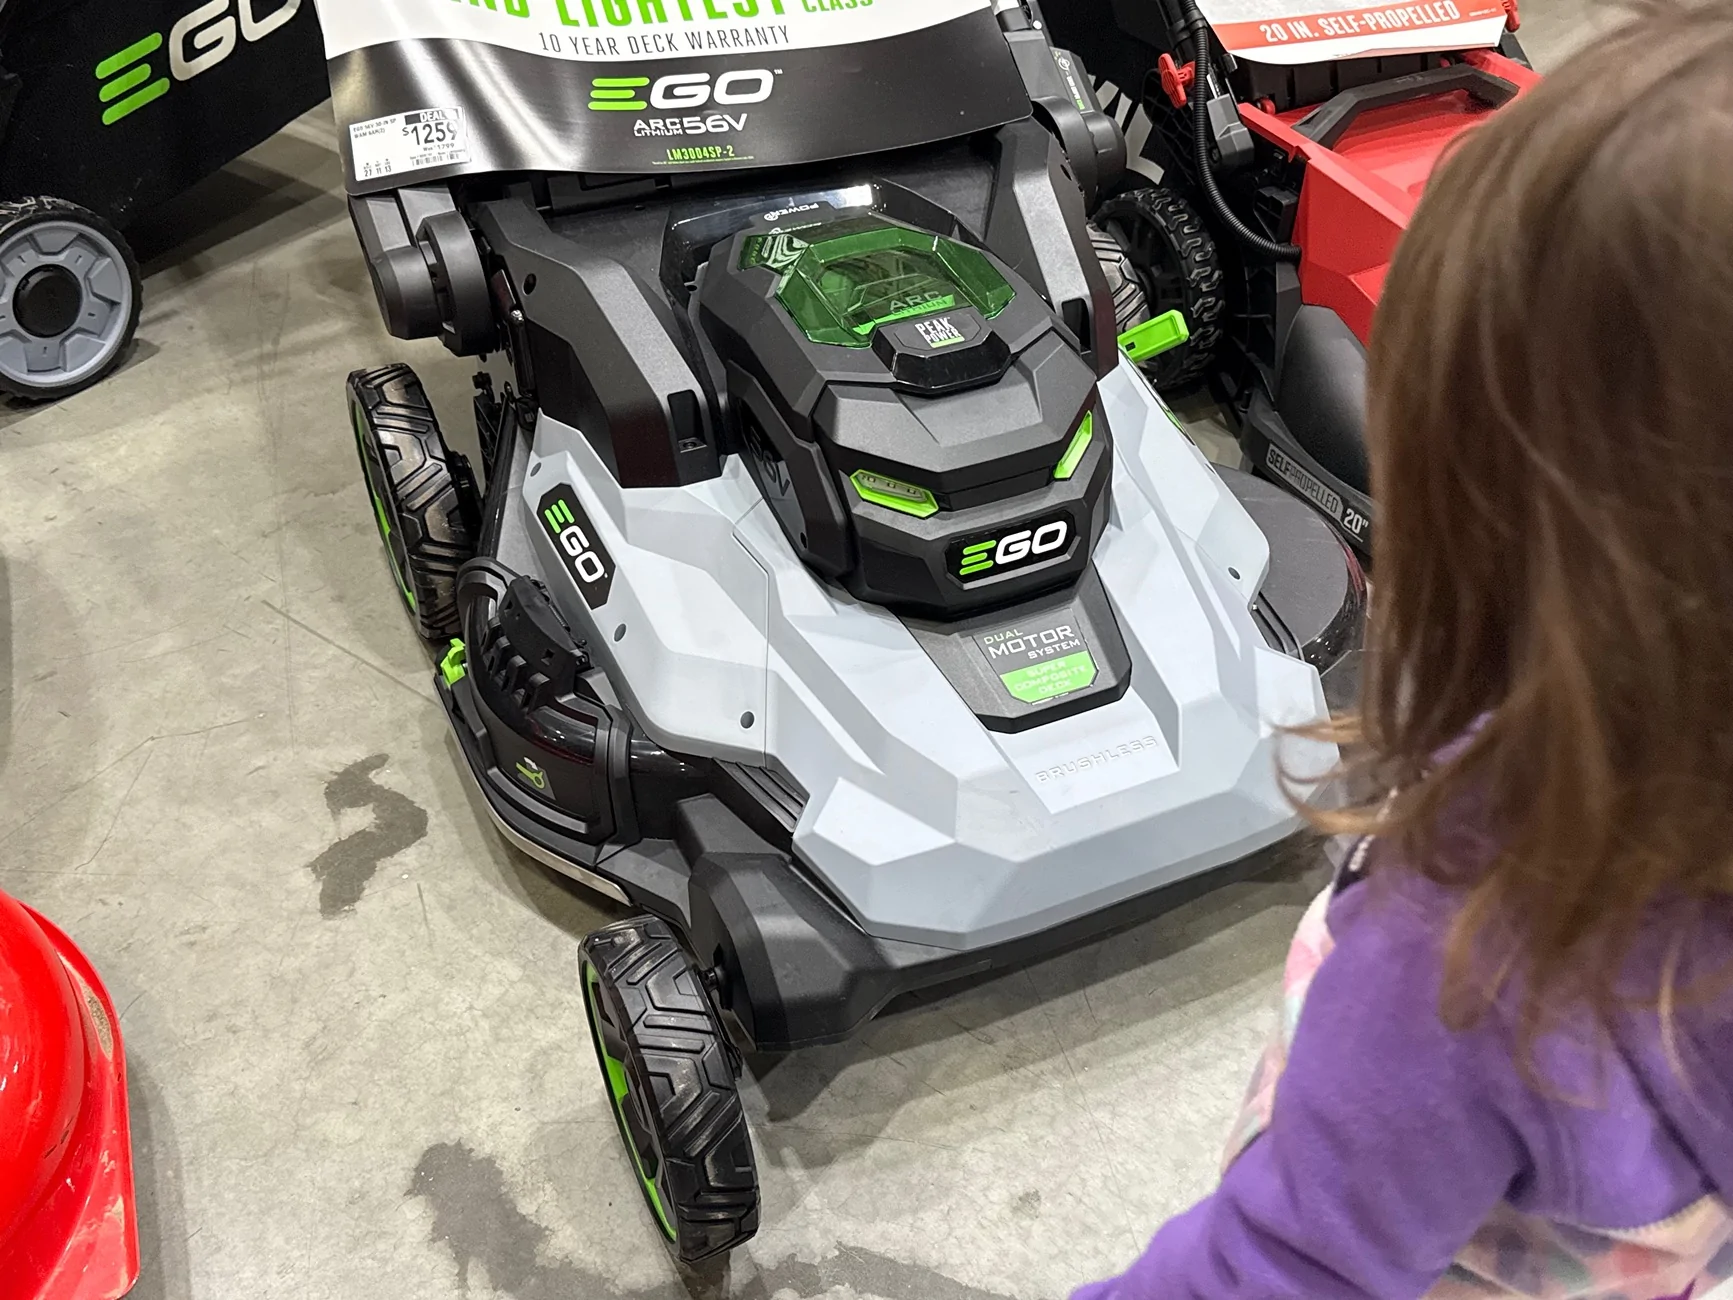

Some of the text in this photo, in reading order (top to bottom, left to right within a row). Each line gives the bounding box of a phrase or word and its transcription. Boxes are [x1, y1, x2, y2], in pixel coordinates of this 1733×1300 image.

[1260, 24, 1288, 43] 20
[1288, 18, 1319, 40] IN.
[1318, 1, 1461, 37] SELF-PROPELLED
[538, 25, 789, 56] 10 YEAR DECK WARRANTY
[588, 69, 774, 111] EGO
[420, 110, 447, 122] DEAL
[633, 113, 748, 135] ARC 56V
[633, 128, 684, 138] LITHIUM
[666, 144, 736, 161] LM3004SP-2
[890, 291, 942, 311] ARC
[915, 316, 953, 335] PEAK
[924, 328, 962, 344] POWER
[544, 499, 606, 583] EGO
[959, 520, 1068, 576] EGO
[983, 628, 1024, 645] DUAL
[987, 625, 1075, 659] MOTOR
[1027, 638, 1081, 660] SYSTEM
[1035, 735, 1158, 782] BRUSHLESS
